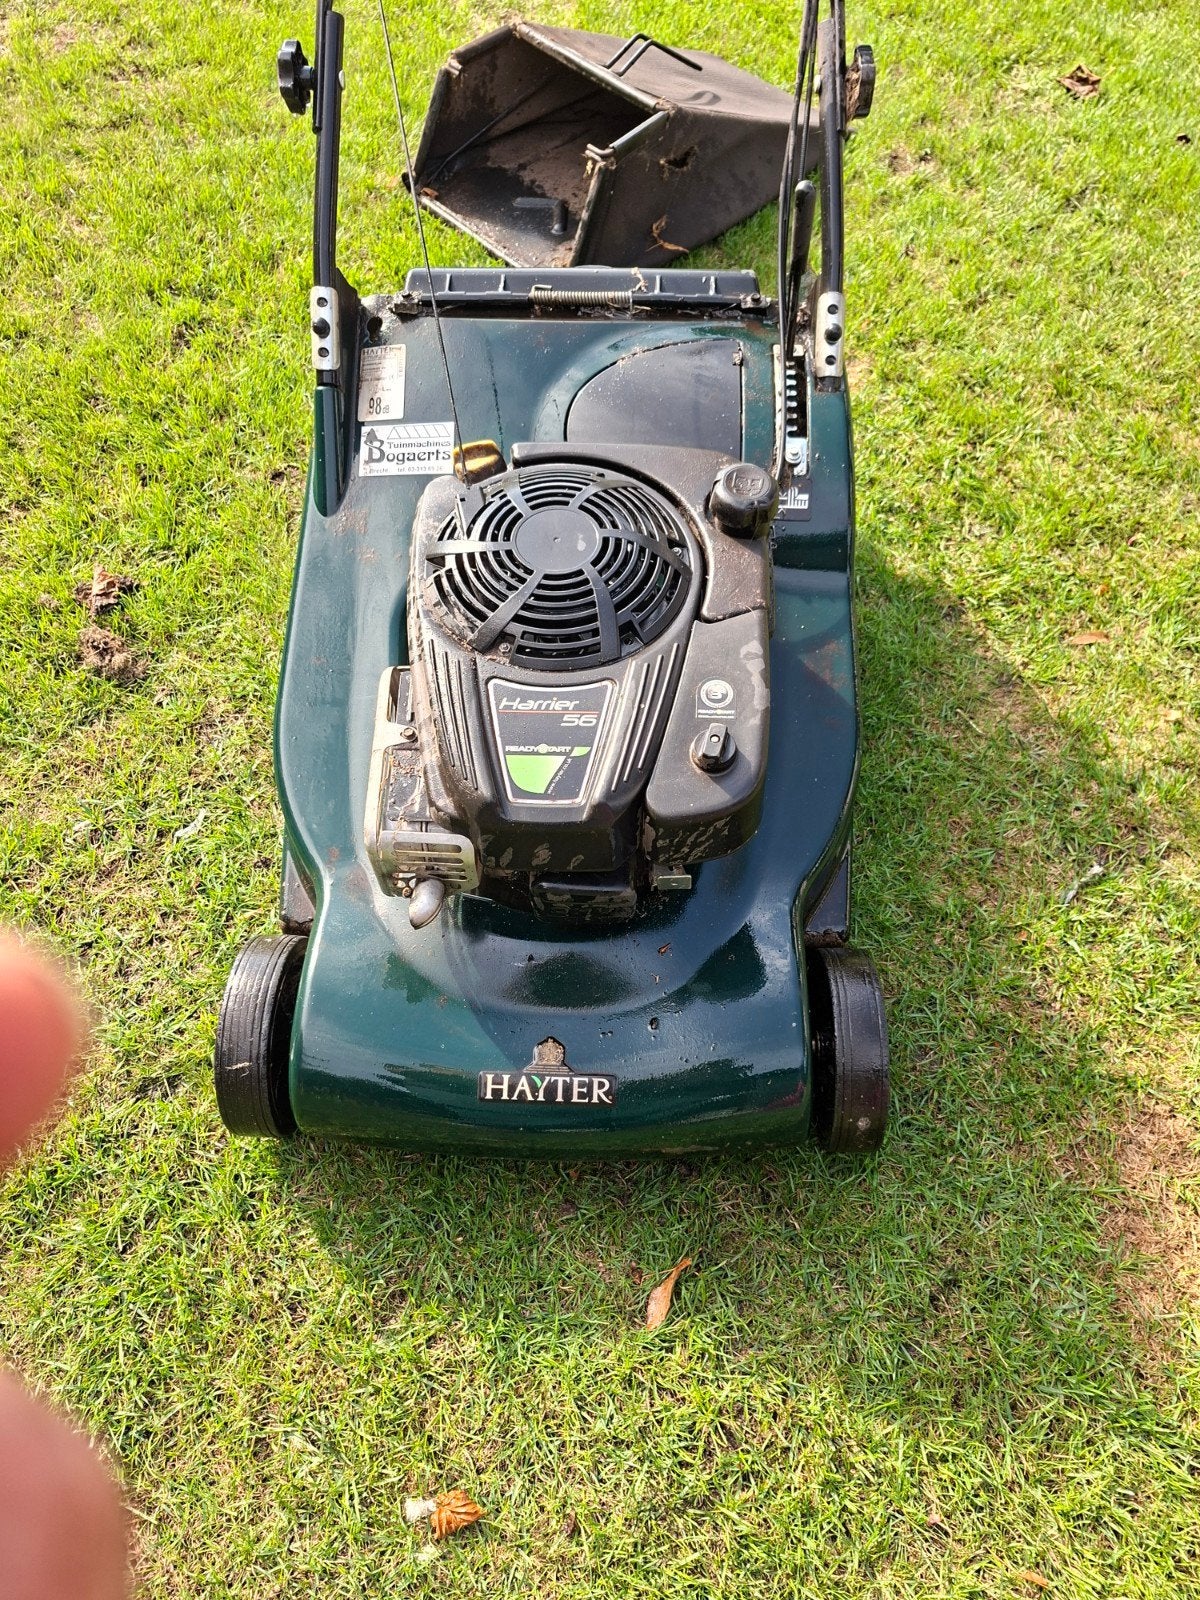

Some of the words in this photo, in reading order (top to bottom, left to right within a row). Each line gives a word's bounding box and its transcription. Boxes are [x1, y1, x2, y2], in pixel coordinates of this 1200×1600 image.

[368, 396, 382, 415] 98
[364, 438, 451, 465] Bogaerts
[387, 440, 451, 449] Tuinmachines
[498, 697, 580, 711] Harrier
[560, 714, 598, 727] 56
[484, 1073, 613, 1104] HAYTER
